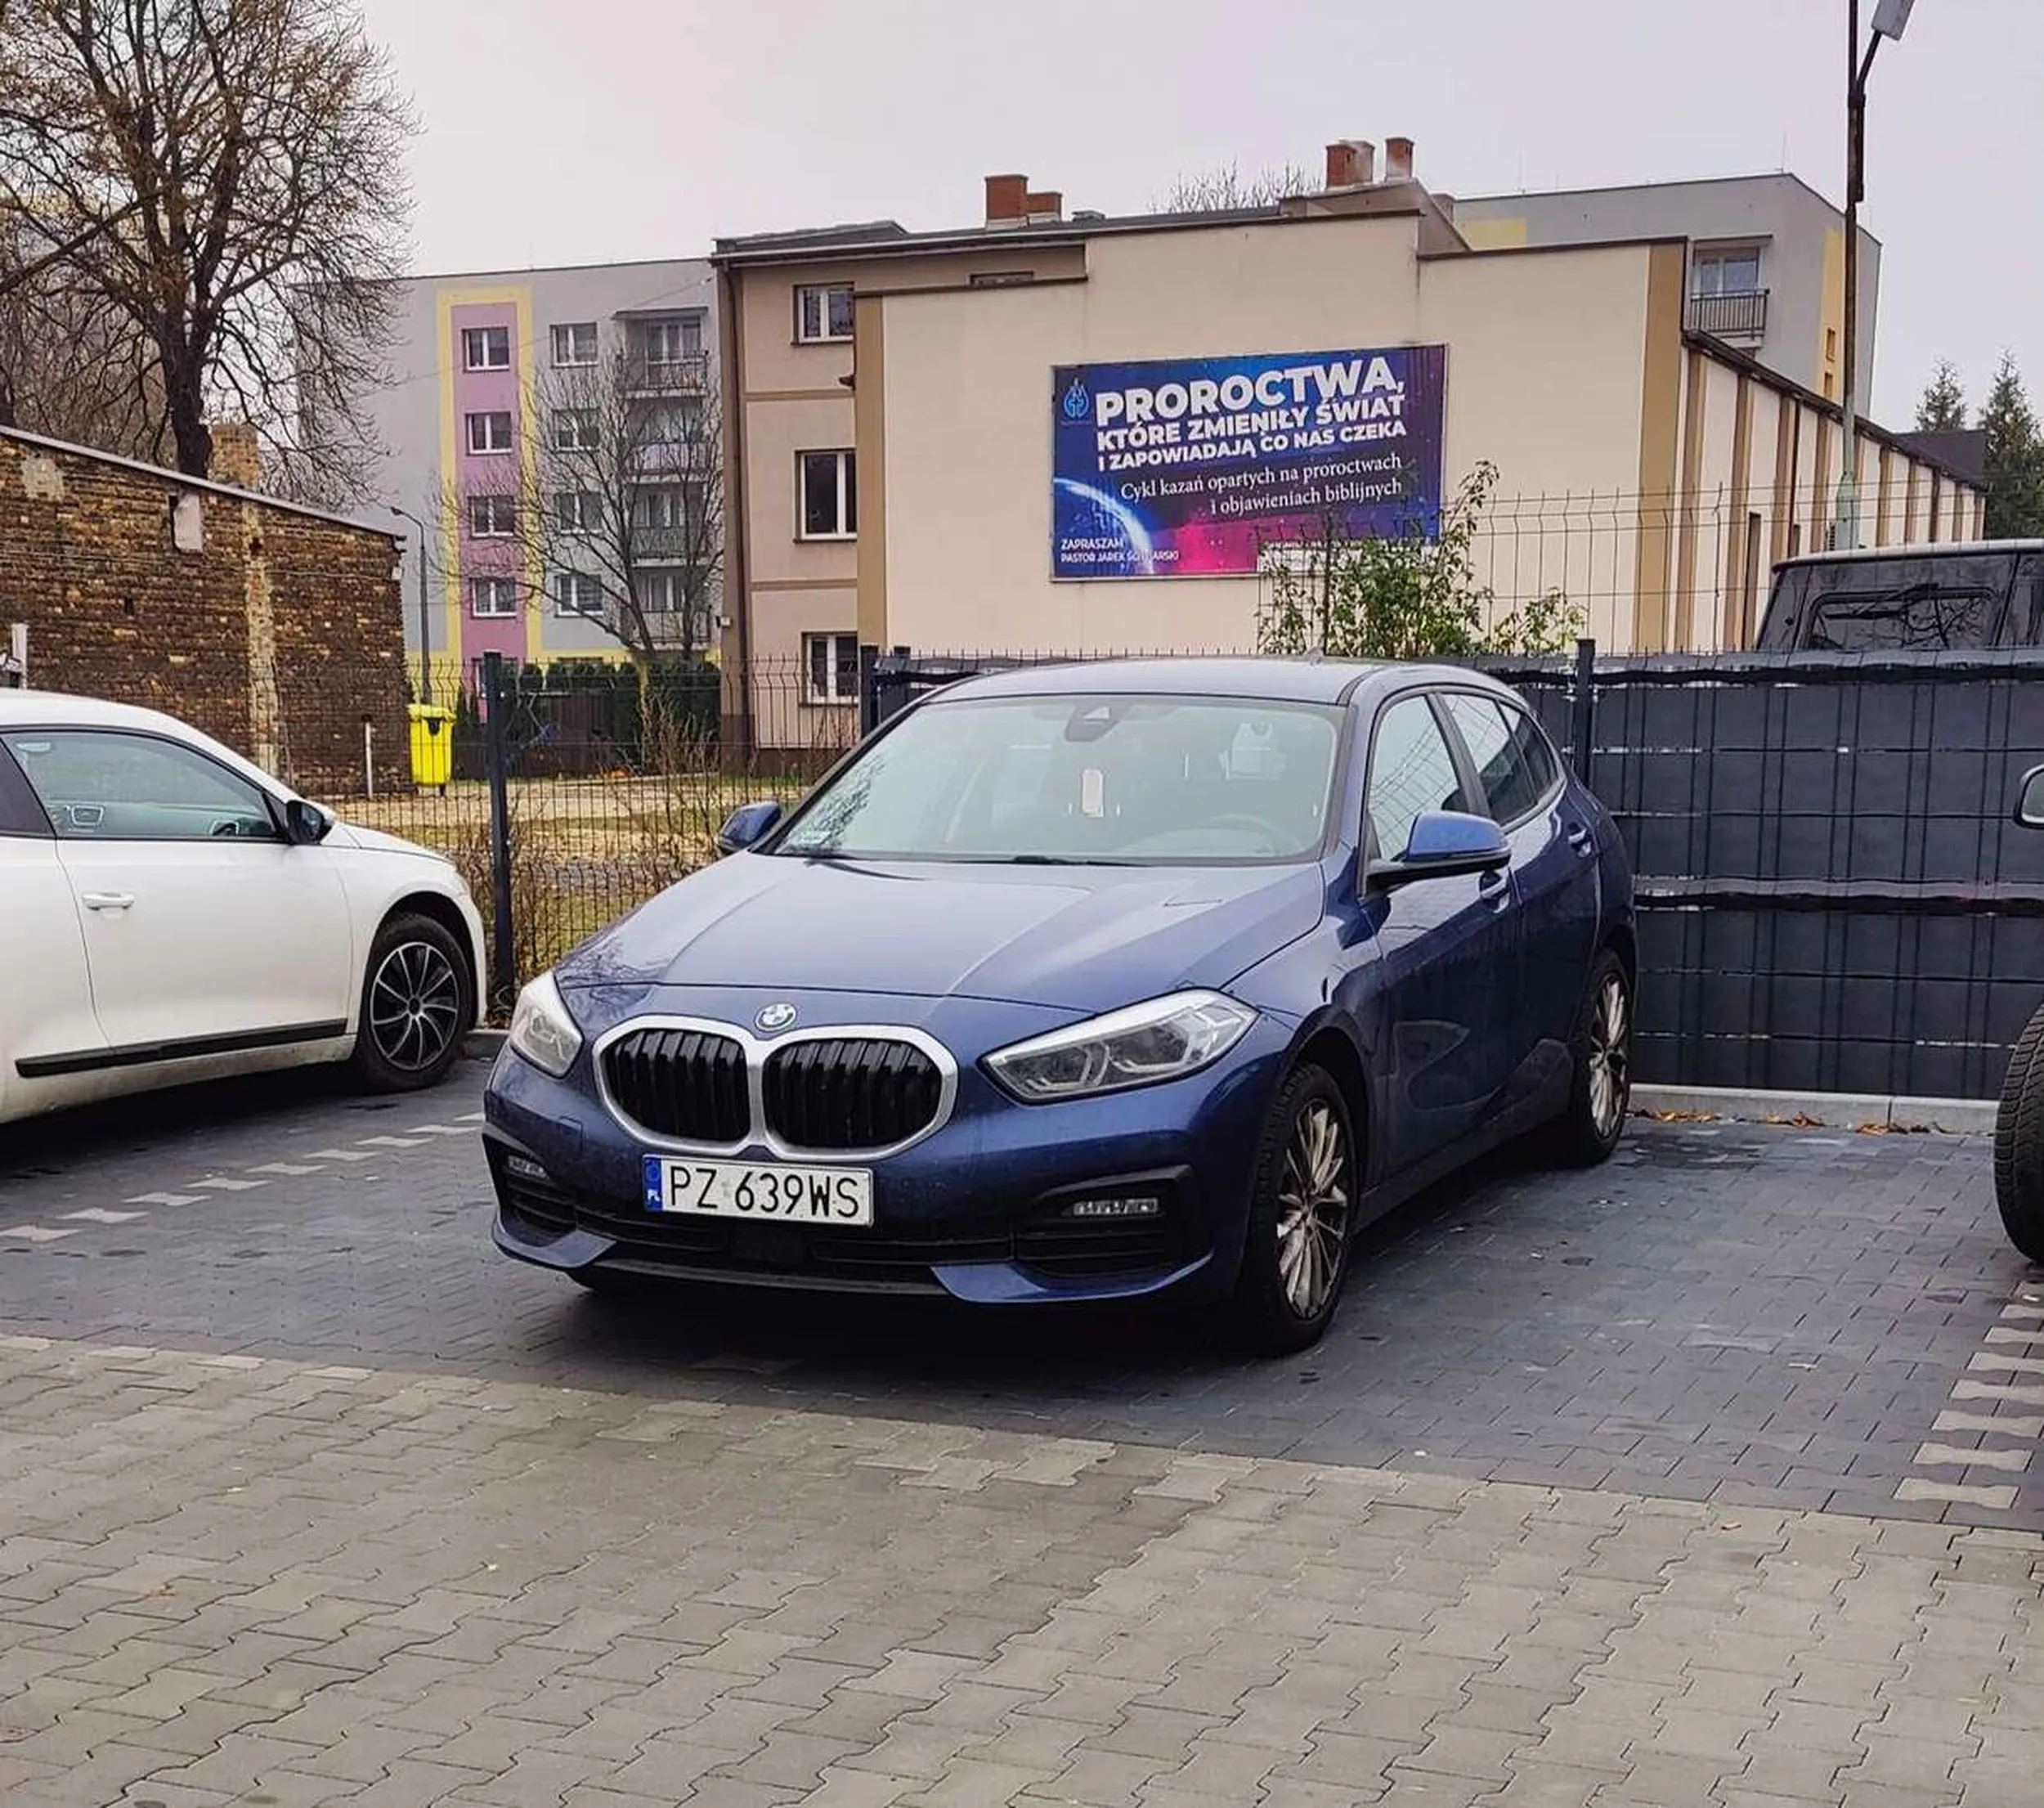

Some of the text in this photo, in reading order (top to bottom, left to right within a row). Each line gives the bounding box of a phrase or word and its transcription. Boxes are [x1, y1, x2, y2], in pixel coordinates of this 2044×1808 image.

[1096, 357, 1405, 427] PROROCTWA,
[1097, 394, 1405, 451] KTÓRE ZMIENIŁY ŚWIAT
[1099, 420, 1406, 471] I ZAPOWIADAJĄ CO NAS CZEKA
[1121, 452, 1401, 504] Cykl kazań opartych na proroctwach
[1212, 478, 1402, 515] i objawieniach biblijnych
[647, 1189, 660, 1201] PL
[670, 1166, 858, 1218] PZ 639WS
